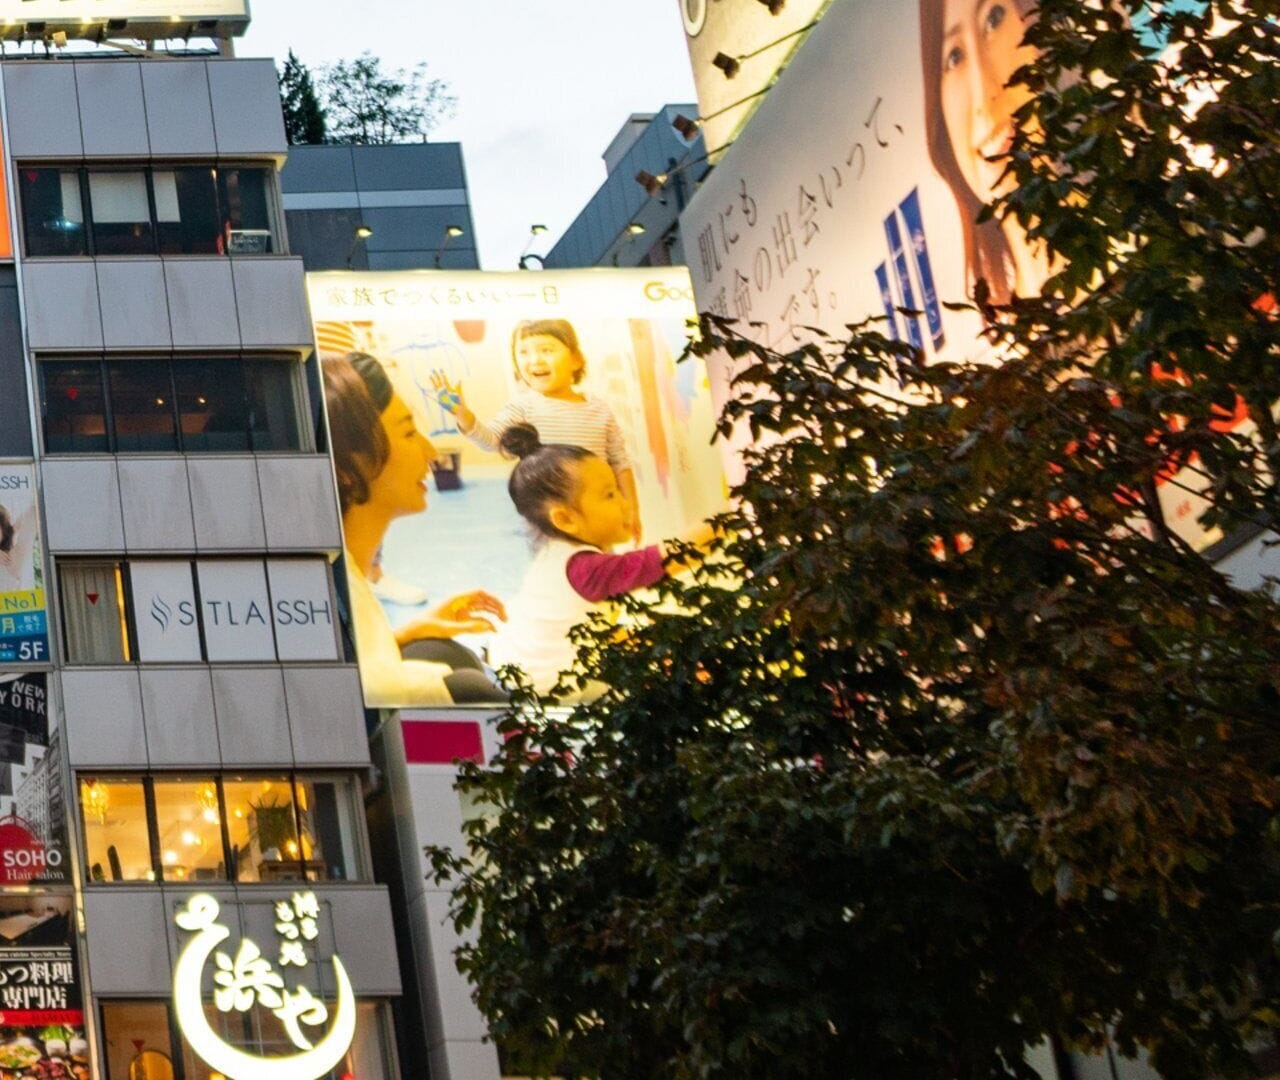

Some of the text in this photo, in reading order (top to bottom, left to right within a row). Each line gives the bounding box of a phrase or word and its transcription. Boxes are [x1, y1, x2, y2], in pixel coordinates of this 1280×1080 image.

[697, 178, 757, 284] 肌にも
[178, 600, 331, 627] STLASSH
[18, 641, 44, 660] 5F
[3, 849, 62, 868] SOHO
[6, 868, 64, 881] Hair salon
[3, 986, 67, 1010] 専門店
